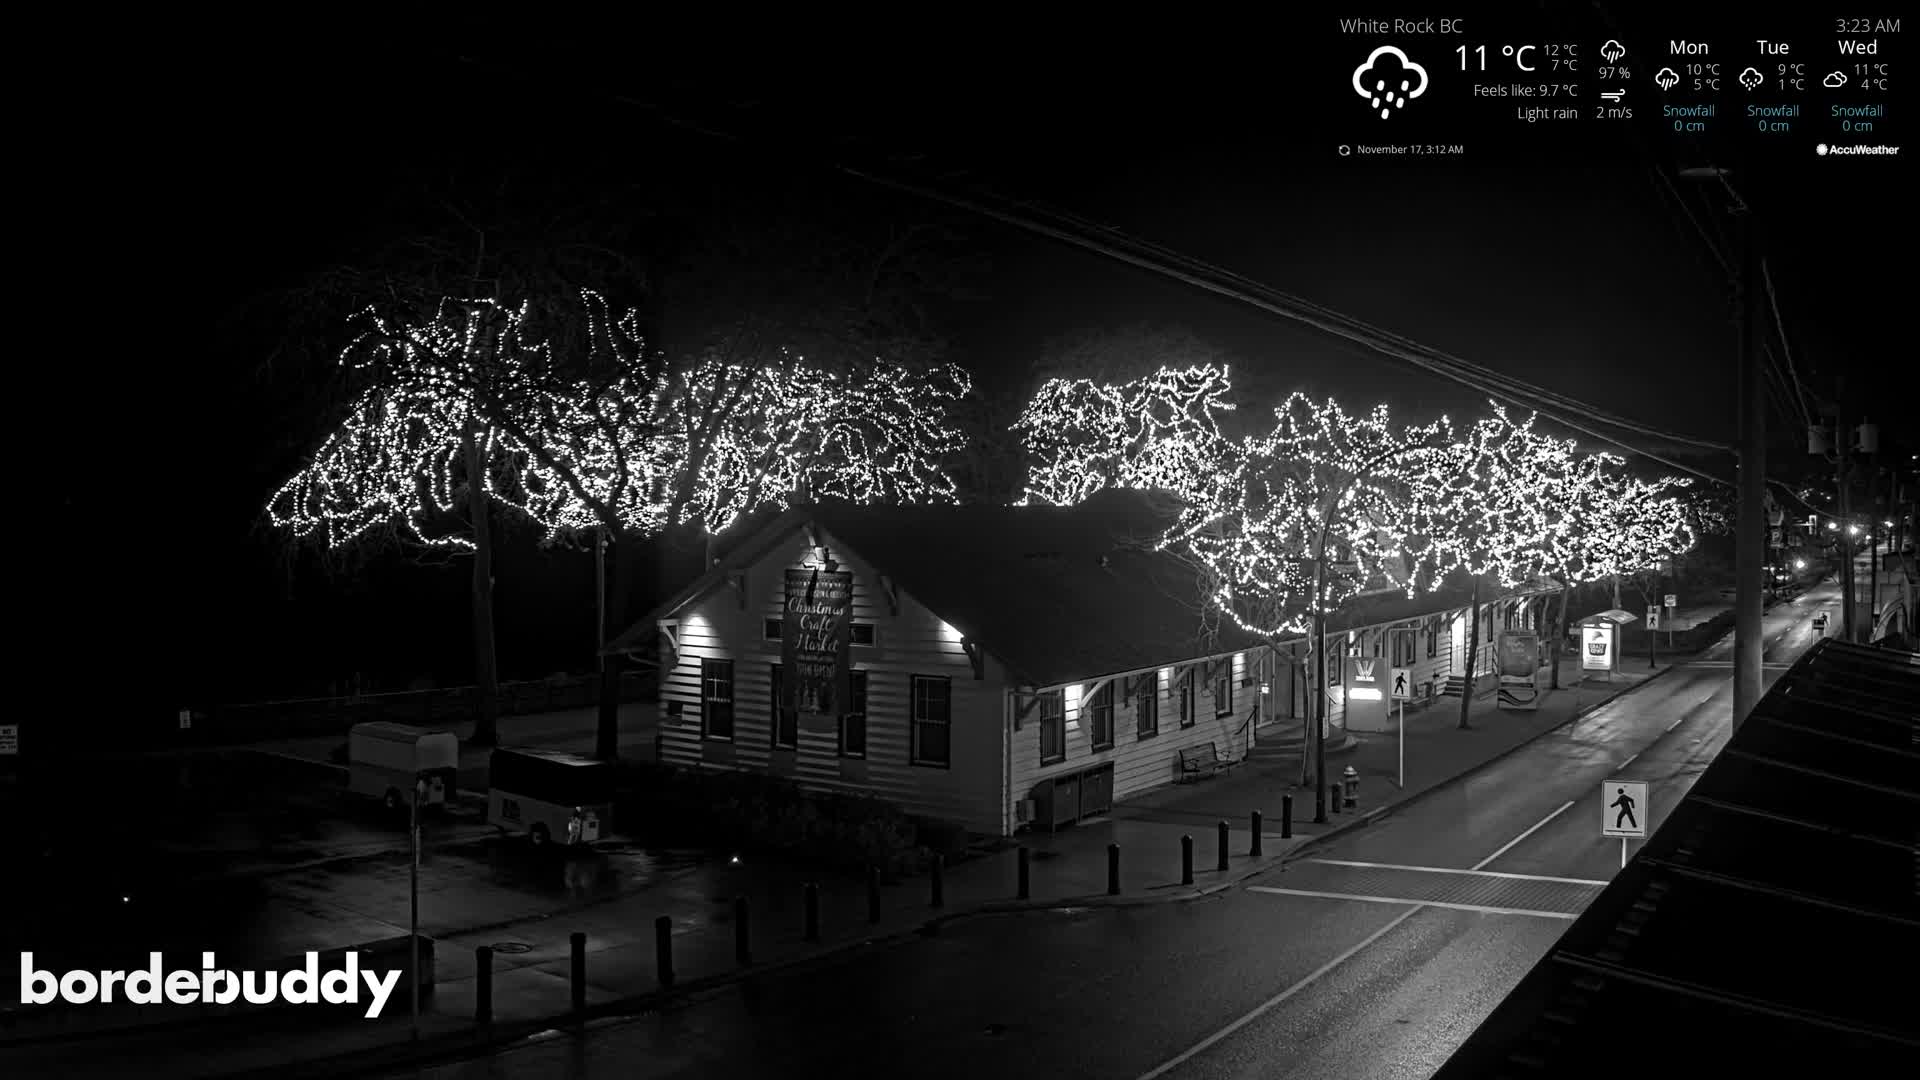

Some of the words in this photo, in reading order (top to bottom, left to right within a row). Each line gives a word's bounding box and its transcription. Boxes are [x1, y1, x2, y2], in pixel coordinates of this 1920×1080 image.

[788, 597, 844, 616] Christmas
[800, 614, 832, 641] Craft
[795, 634, 840, 652] Market
